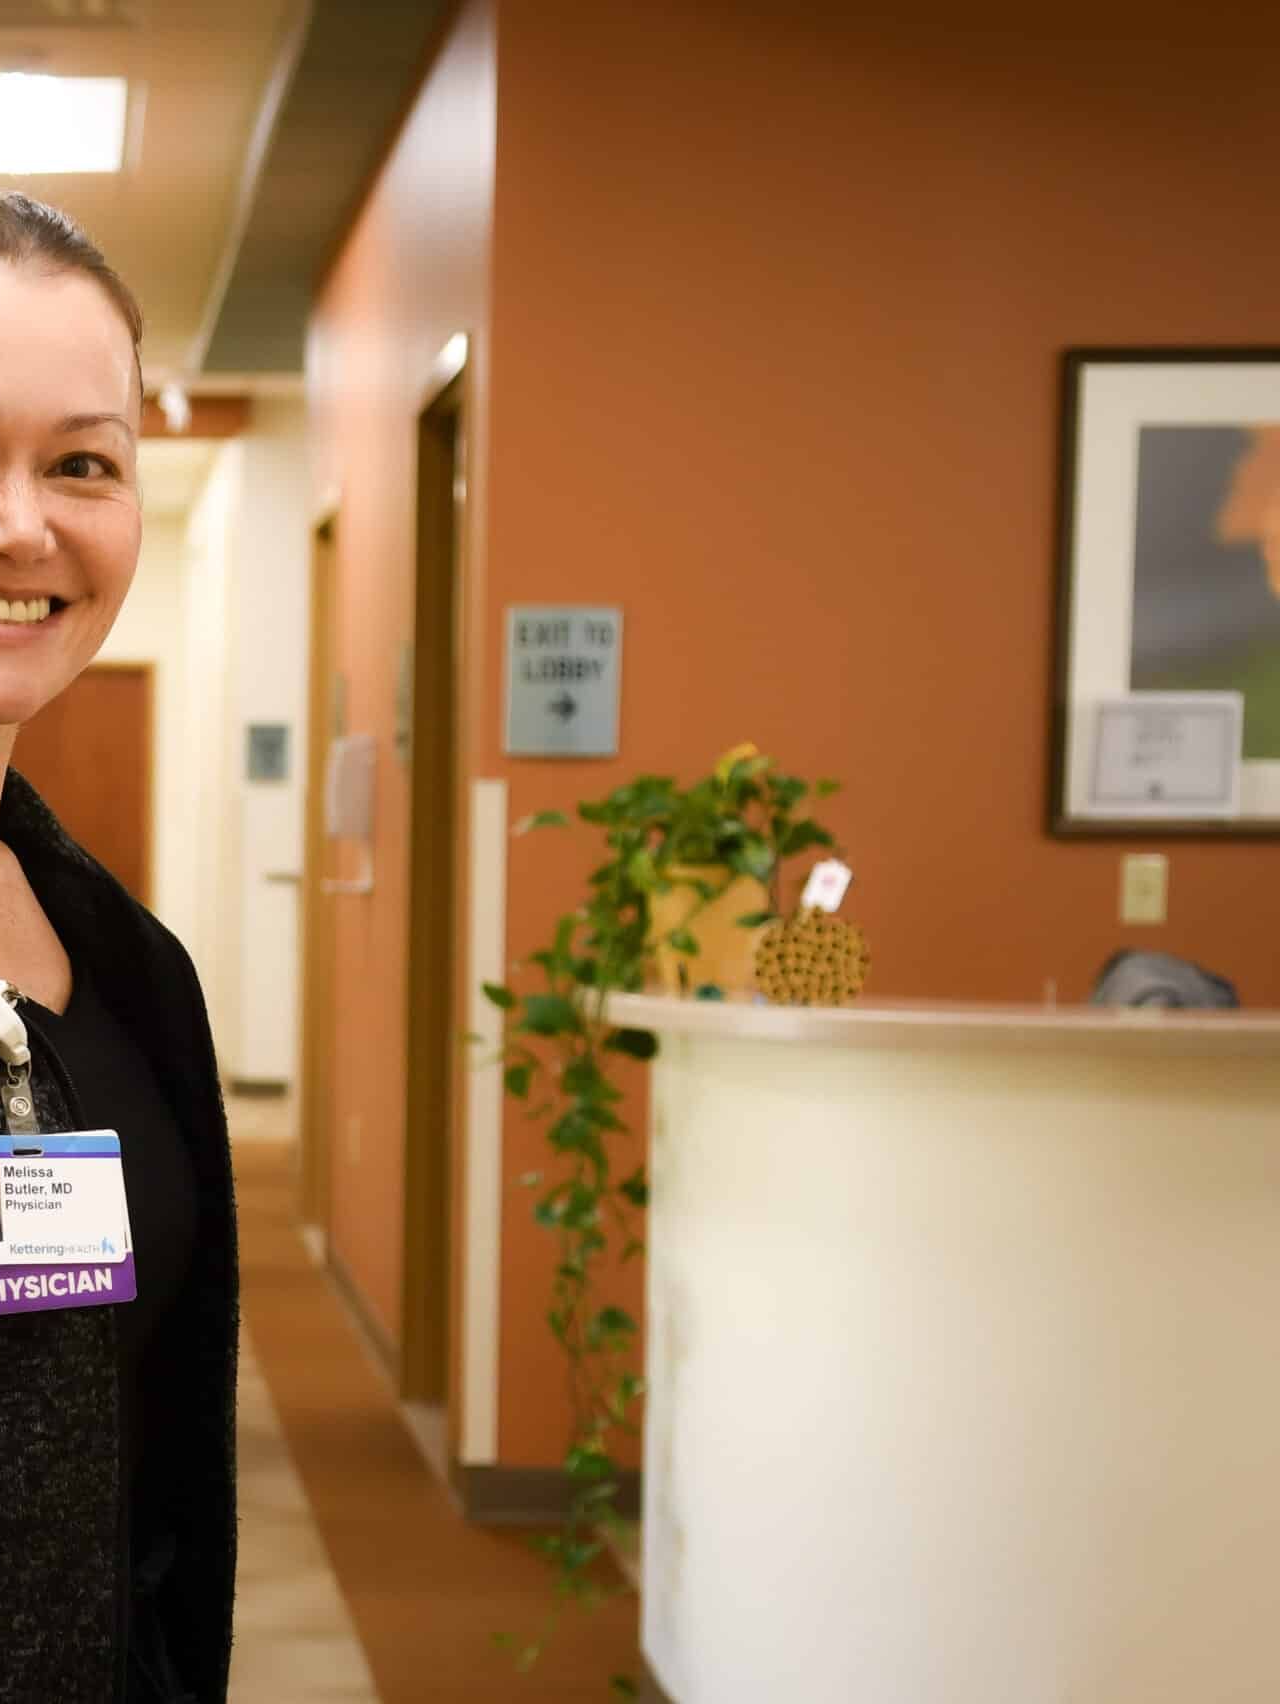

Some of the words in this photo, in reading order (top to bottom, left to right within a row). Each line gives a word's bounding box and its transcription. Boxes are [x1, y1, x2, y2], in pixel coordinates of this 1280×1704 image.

[516, 619, 569, 647] EXIT
[584, 620, 615, 647] TO
[523, 656, 605, 682] LOBBY
[3, 1165, 54, 1178] Melissa
[4, 1183, 48, 1196] Butler,
[51, 1182, 73, 1195] MD
[5, 1199, 62, 1213] Physician
